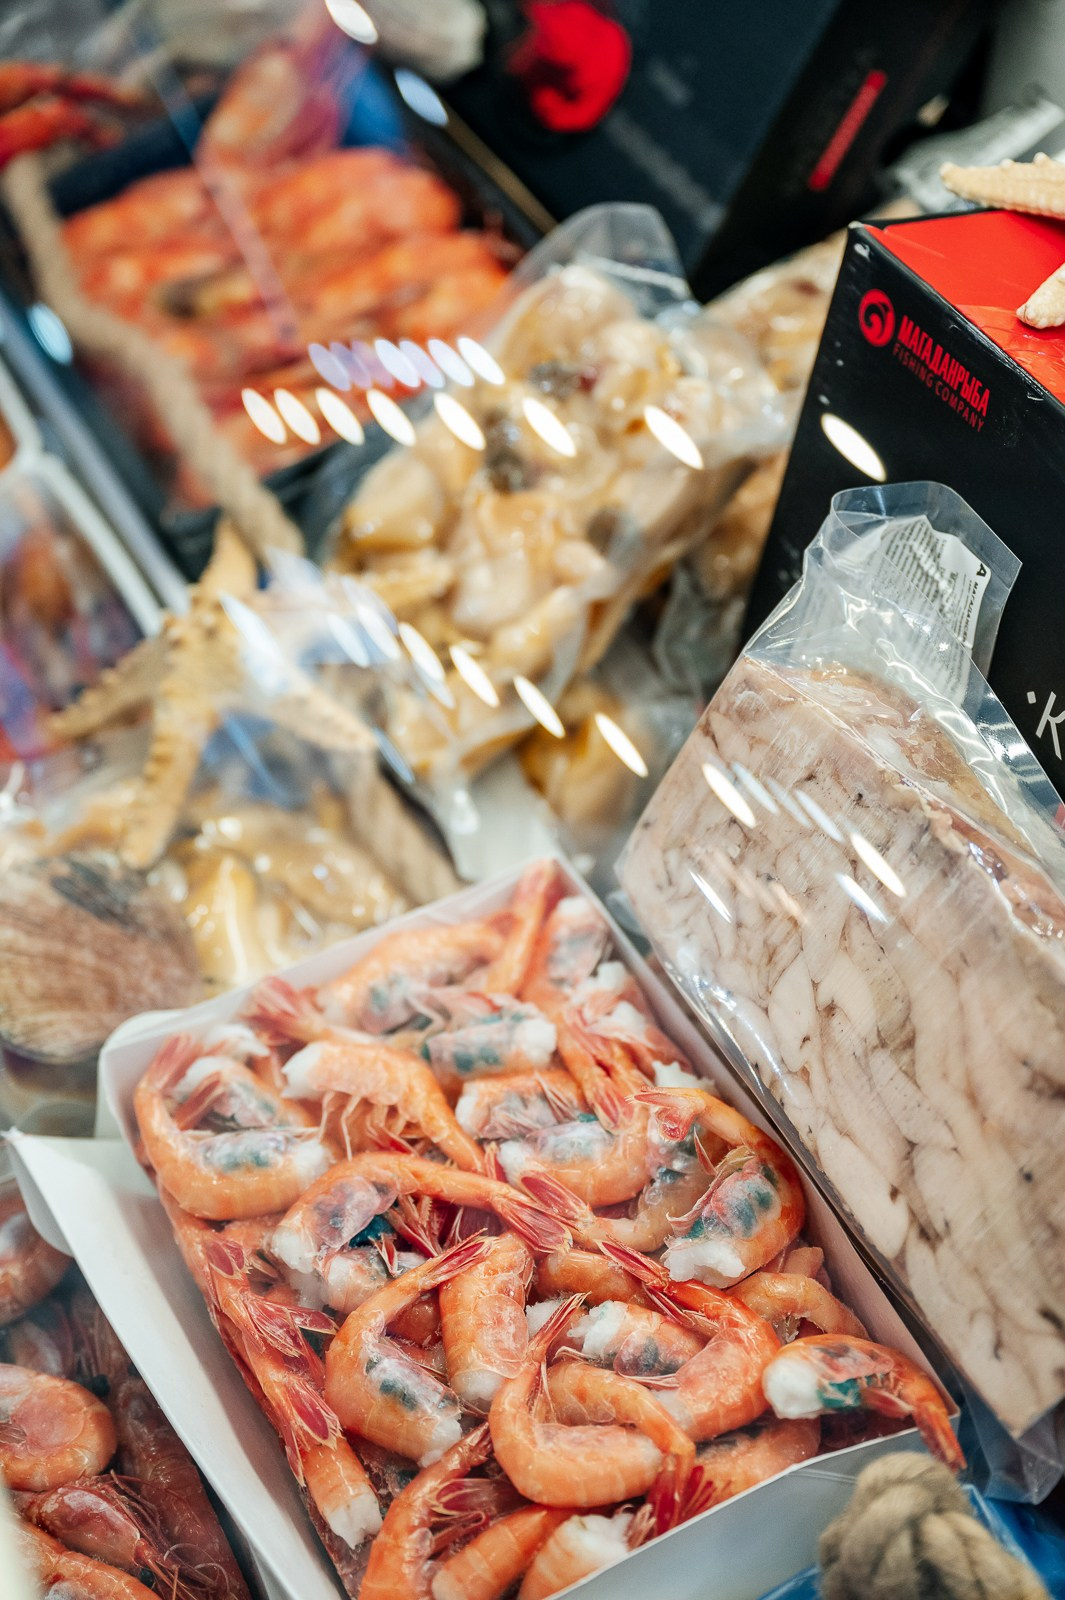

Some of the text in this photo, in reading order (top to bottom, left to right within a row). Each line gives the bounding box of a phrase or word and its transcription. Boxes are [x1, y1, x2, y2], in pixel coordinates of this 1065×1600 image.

[893, 343, 984, 432] FISHING COMPANY
[898, 315, 990, 417] МАГАДАНРЫБА
